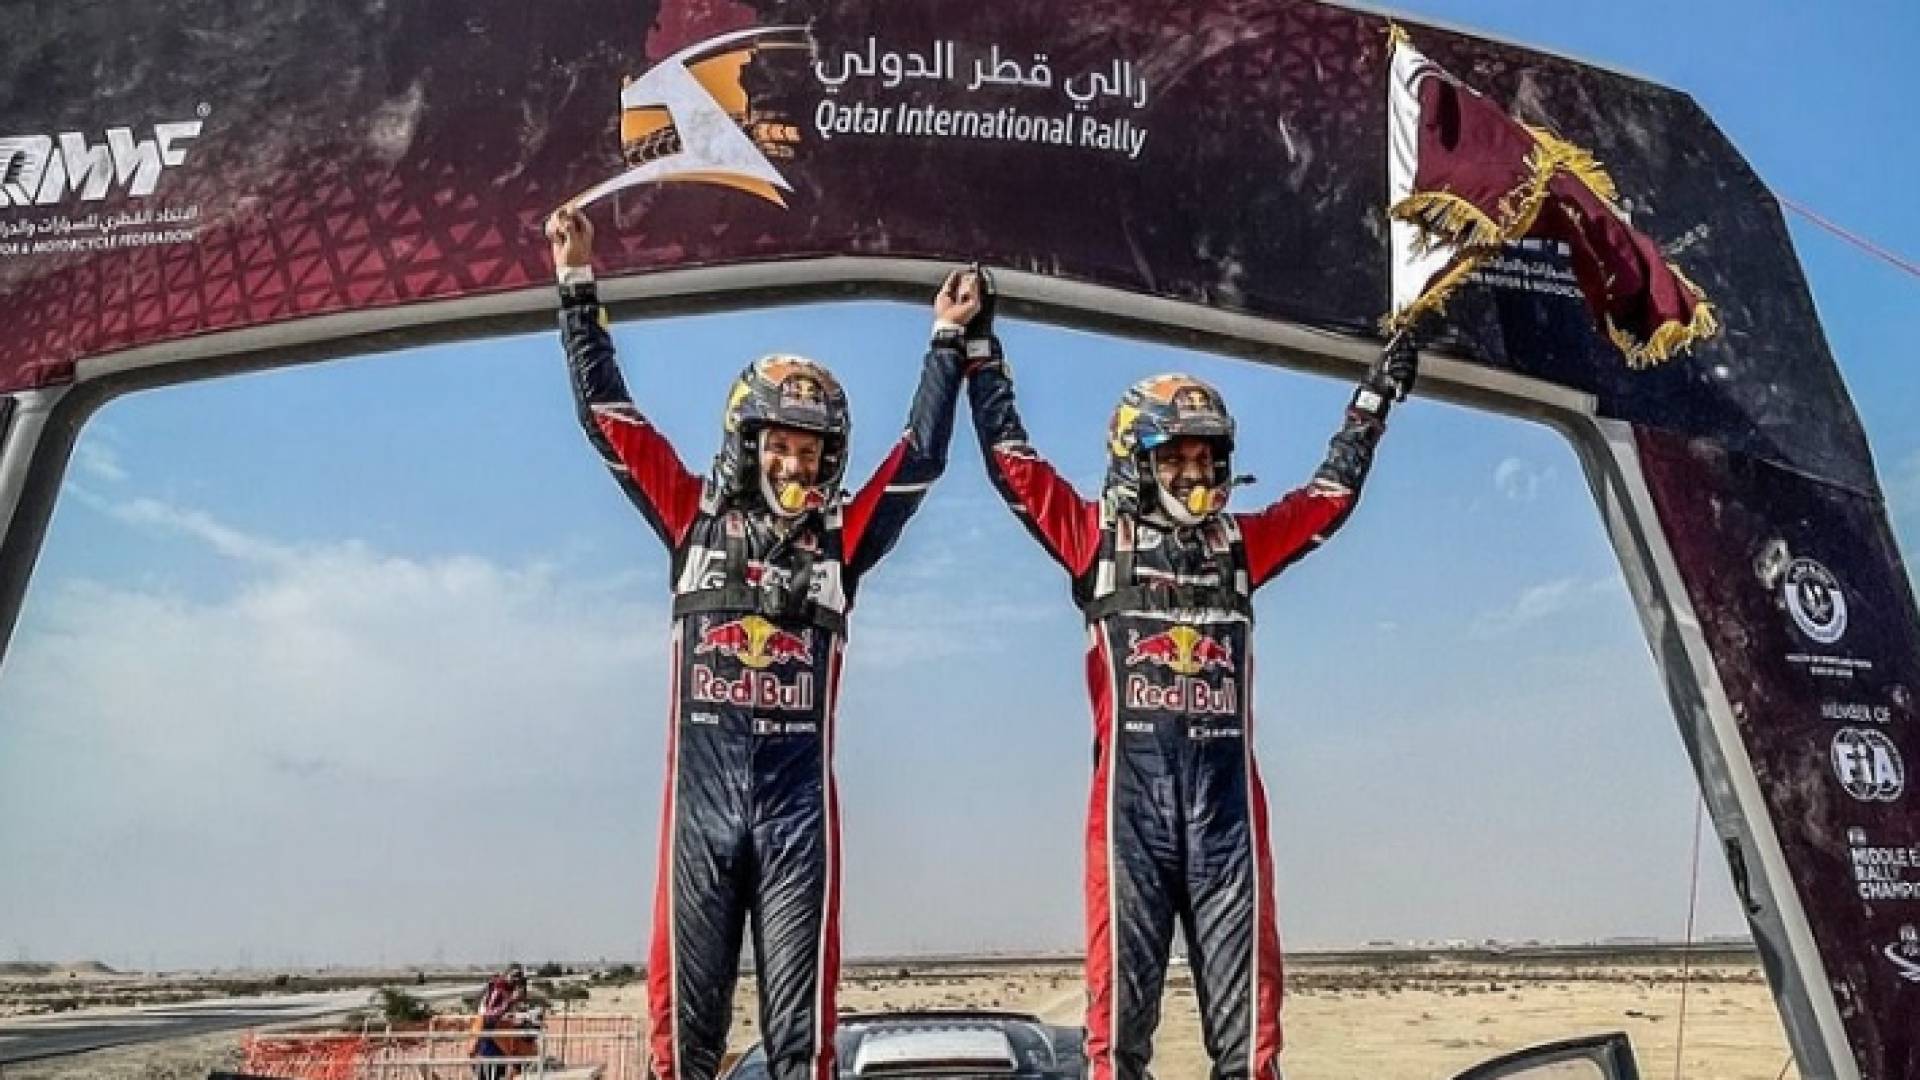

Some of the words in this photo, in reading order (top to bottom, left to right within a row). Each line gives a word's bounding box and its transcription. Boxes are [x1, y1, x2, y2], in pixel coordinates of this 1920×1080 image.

[815, 36, 954, 94] الدولي
[967, 44, 1052, 91] قطر
[1065, 58, 1147, 110] رالي
[815, 100, 892, 140] Qatar
[895, 102, 1074, 146] International
[1080, 116, 1148, 159] Rally
[693, 663, 755, 708] Red
[757, 671, 814, 711] Bull
[1125, 673, 1186, 711] Red
[1187, 677, 1237, 715] Bull
